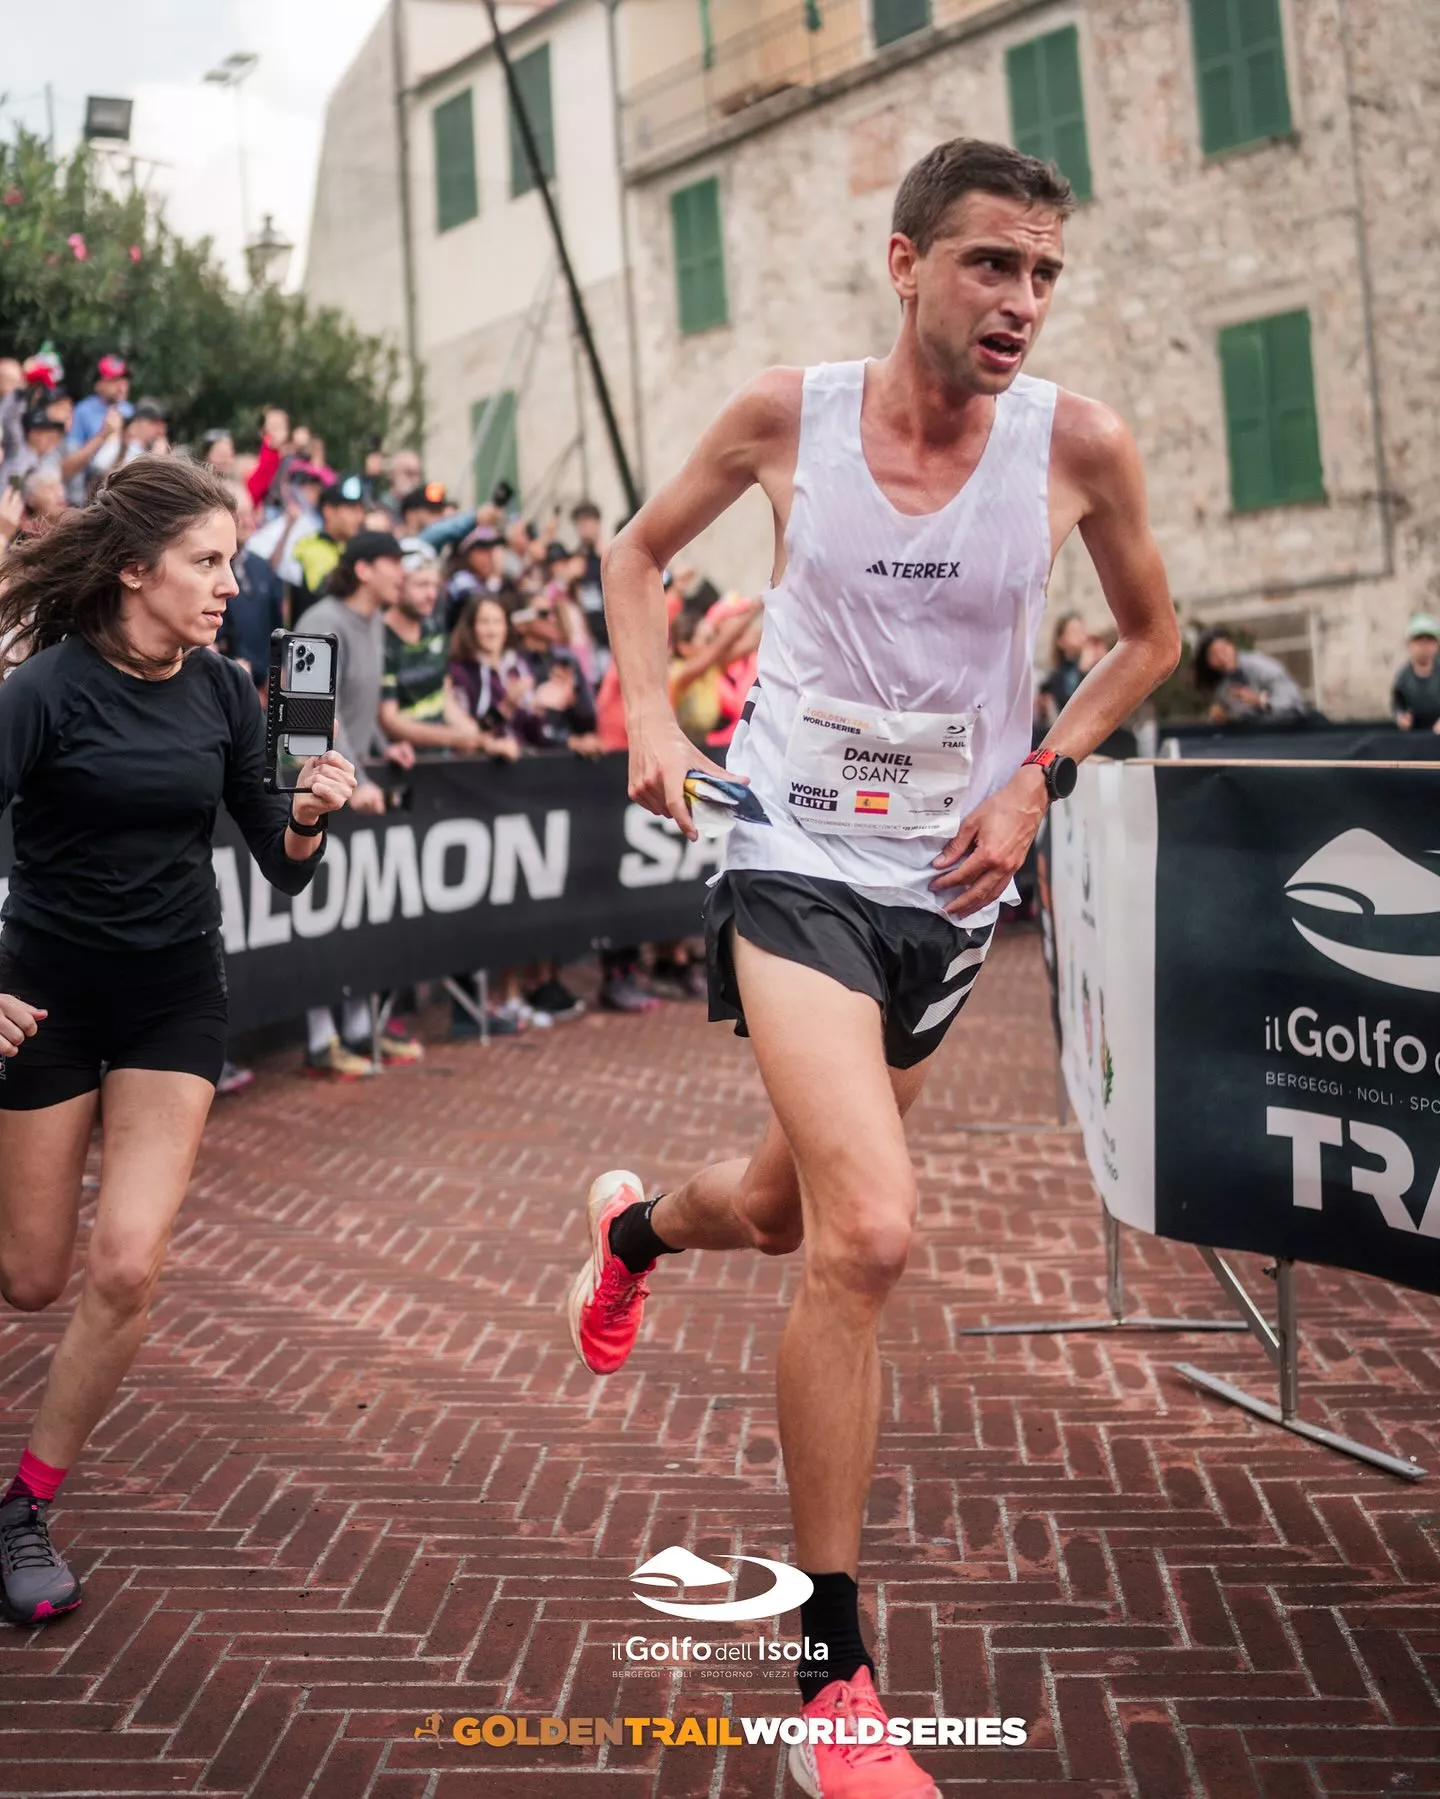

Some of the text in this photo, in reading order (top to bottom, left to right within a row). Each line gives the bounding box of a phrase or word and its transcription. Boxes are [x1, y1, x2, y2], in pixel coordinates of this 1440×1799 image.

[892, 561, 961, 579] TERREX
[844, 747, 913, 767] DANIEL
[842, 765, 909, 784] OSANZ
[791, 782, 839, 798] WORLD
[794, 795, 831, 810] ELITE
[943, 797, 954, 808] 9
[211, 808, 570, 955] ALOMON
[1265, 1016, 1282, 1051] il
[1287, 1006, 1428, 1074] Golfo
[1265, 1071, 1343, 1096] BERGEGGI
[1357, 1087, 1394, 1106] NOLI
